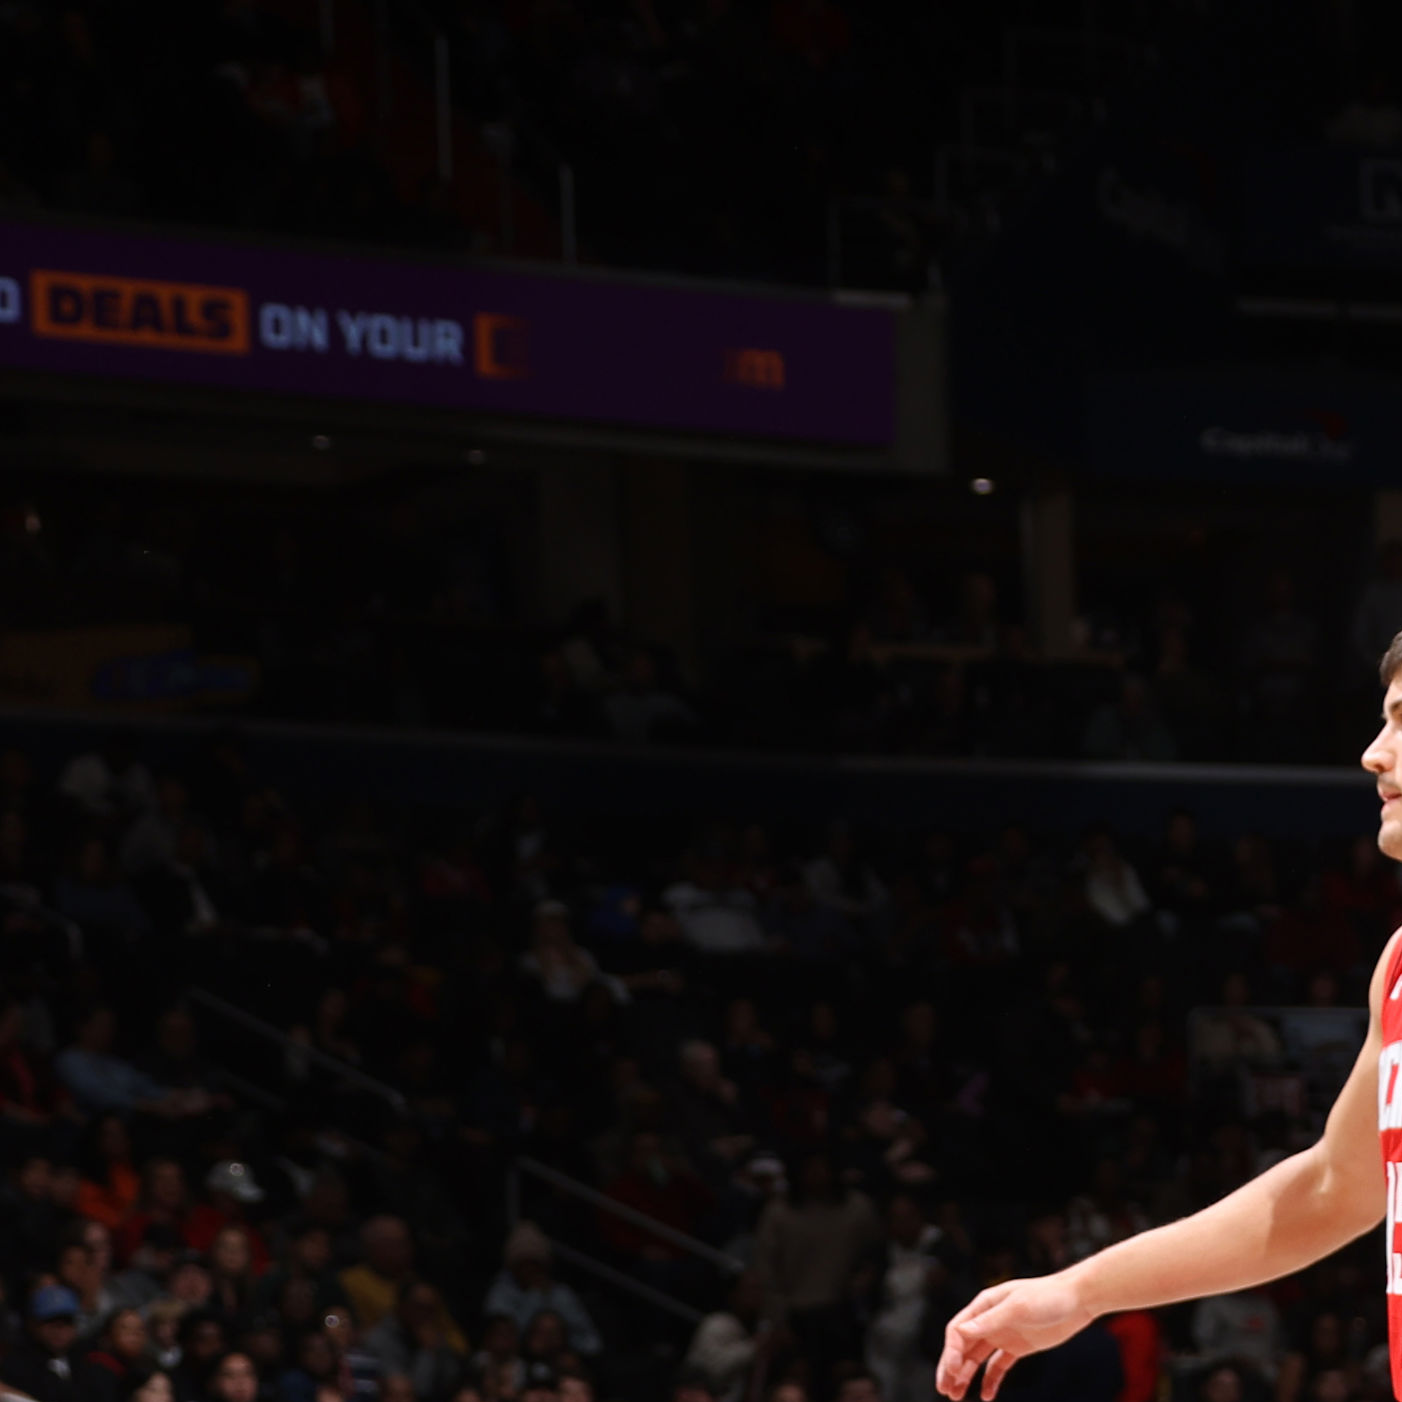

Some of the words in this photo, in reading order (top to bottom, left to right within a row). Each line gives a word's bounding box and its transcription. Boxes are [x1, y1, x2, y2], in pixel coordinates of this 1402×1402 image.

[50, 284, 232, 339] DEALS
[258, 302, 329, 355] ON
[335, 307, 465, 367] YOUR
